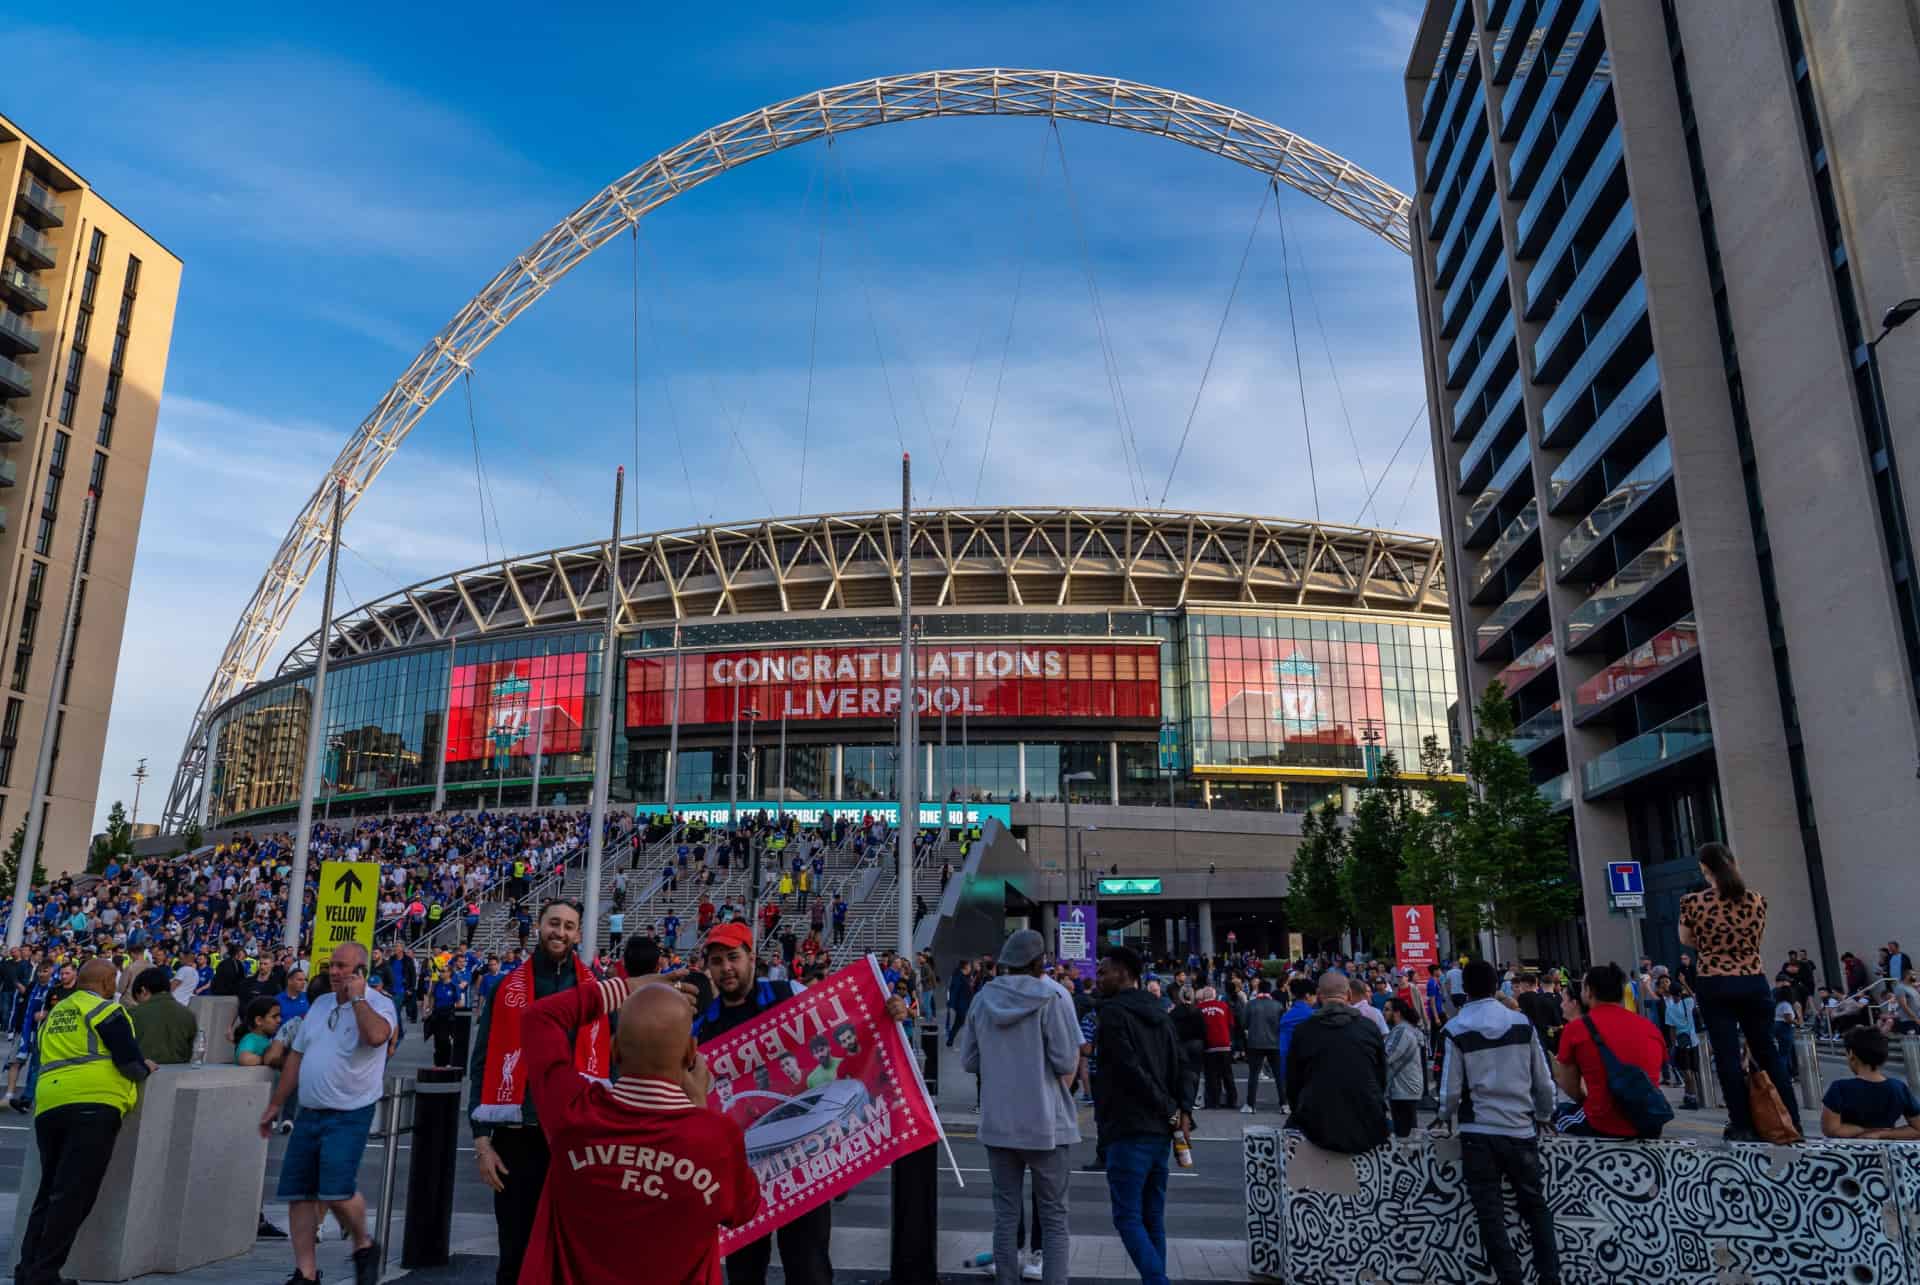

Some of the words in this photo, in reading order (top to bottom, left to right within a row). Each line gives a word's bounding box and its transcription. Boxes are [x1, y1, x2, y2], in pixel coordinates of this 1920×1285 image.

[712, 650, 1061, 683] CONGRATULATIONS
[711, 809, 729, 824] FOR
[325, 904, 367, 923] YELLOW
[329, 925, 357, 942] ZONE
[567, 1144, 721, 1206] LIVERPOOL
[620, 1168, 669, 1200] F.C.
